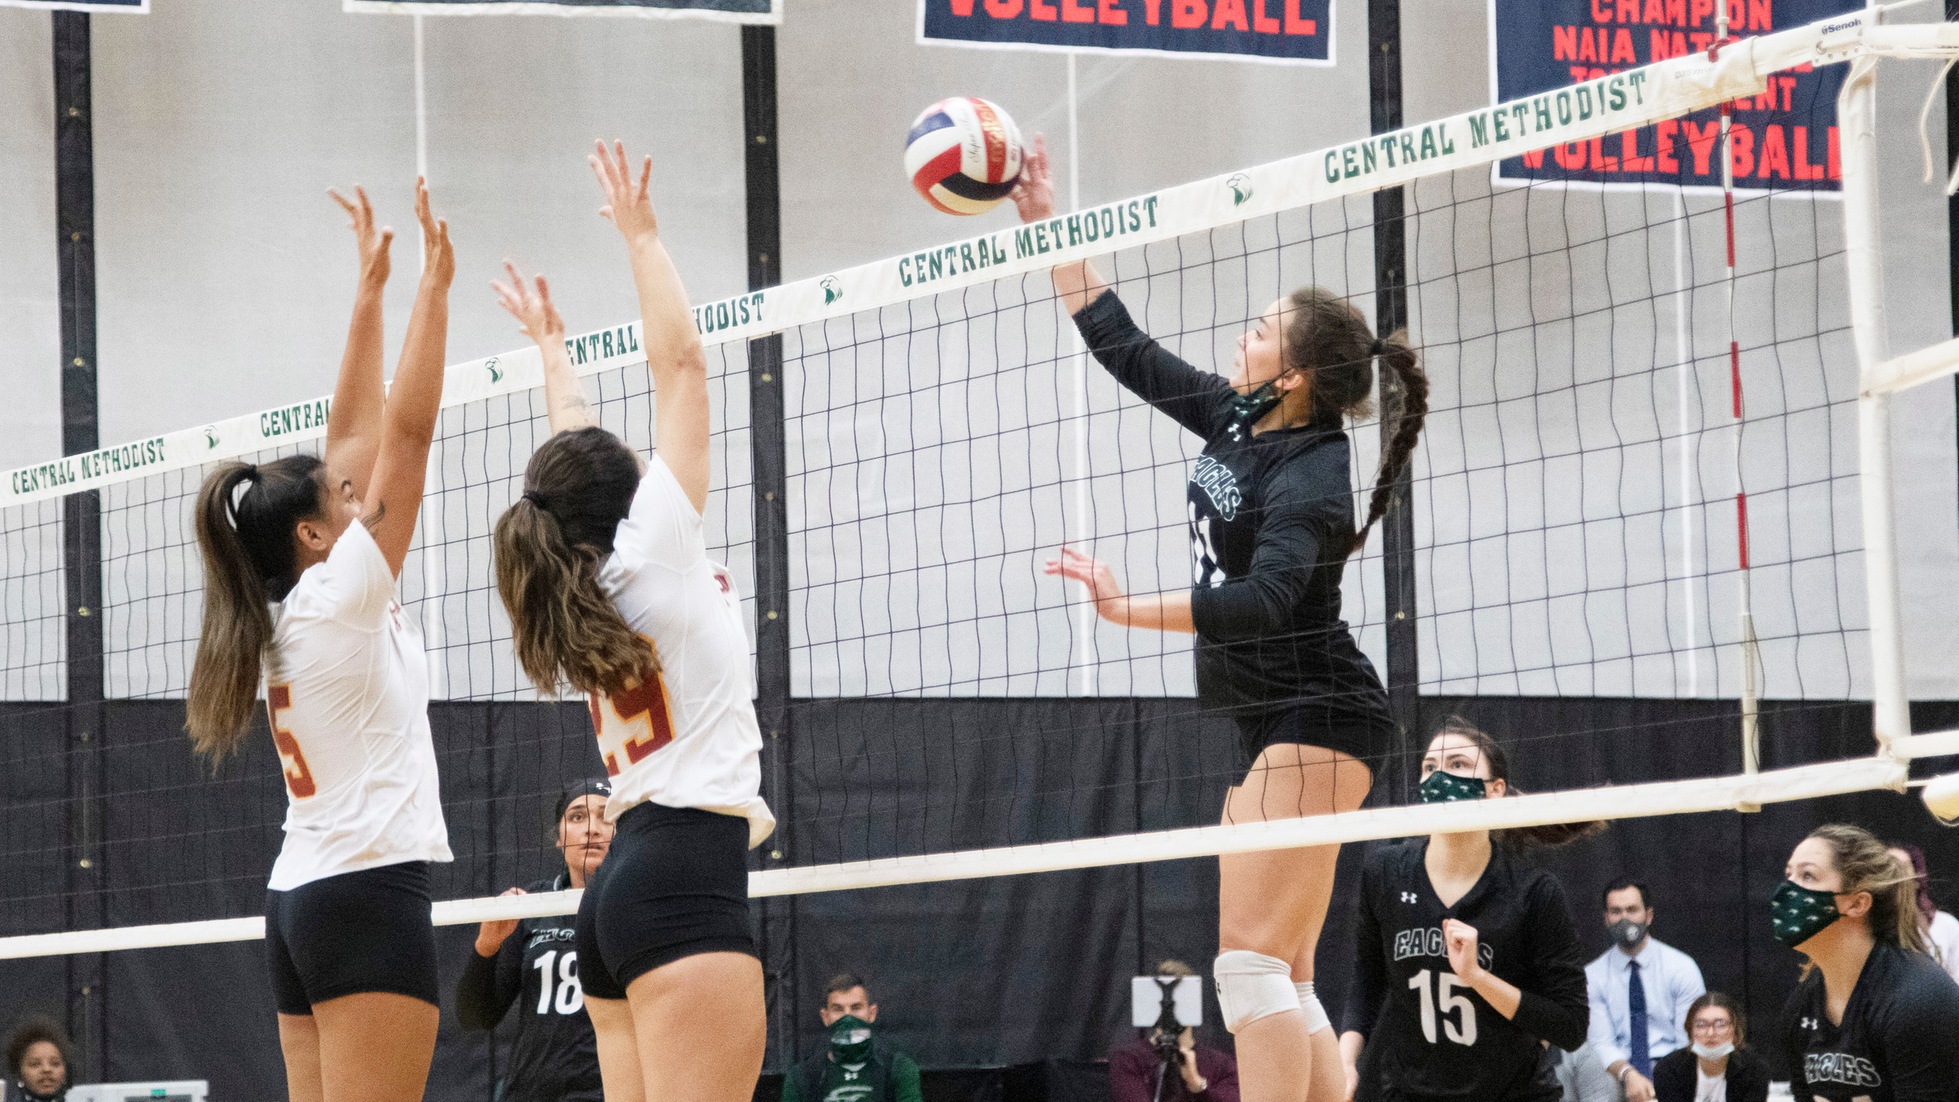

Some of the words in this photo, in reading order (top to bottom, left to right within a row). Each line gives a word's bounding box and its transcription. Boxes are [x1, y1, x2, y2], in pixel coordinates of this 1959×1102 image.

[1553, 25, 1637, 64] NAIA
[1590, 0, 1772, 32] CHAMPON
[1324, 123, 1455, 184] CENTRAL
[1468, 69, 1647, 149] METHODIST
[898, 235, 1007, 288] CENTRAL
[1015, 195, 1159, 260] METHODIST
[565, 324, 639, 366] ENTRAL
[692, 292, 765, 335] ODIST
[12, 460, 76, 495] CENTRAL
[81, 437, 165, 480] METHODIST
[532, 950, 584, 1016] 18
[1394, 927, 1494, 973] EAGS
[1408, 968, 1478, 1047] 15
